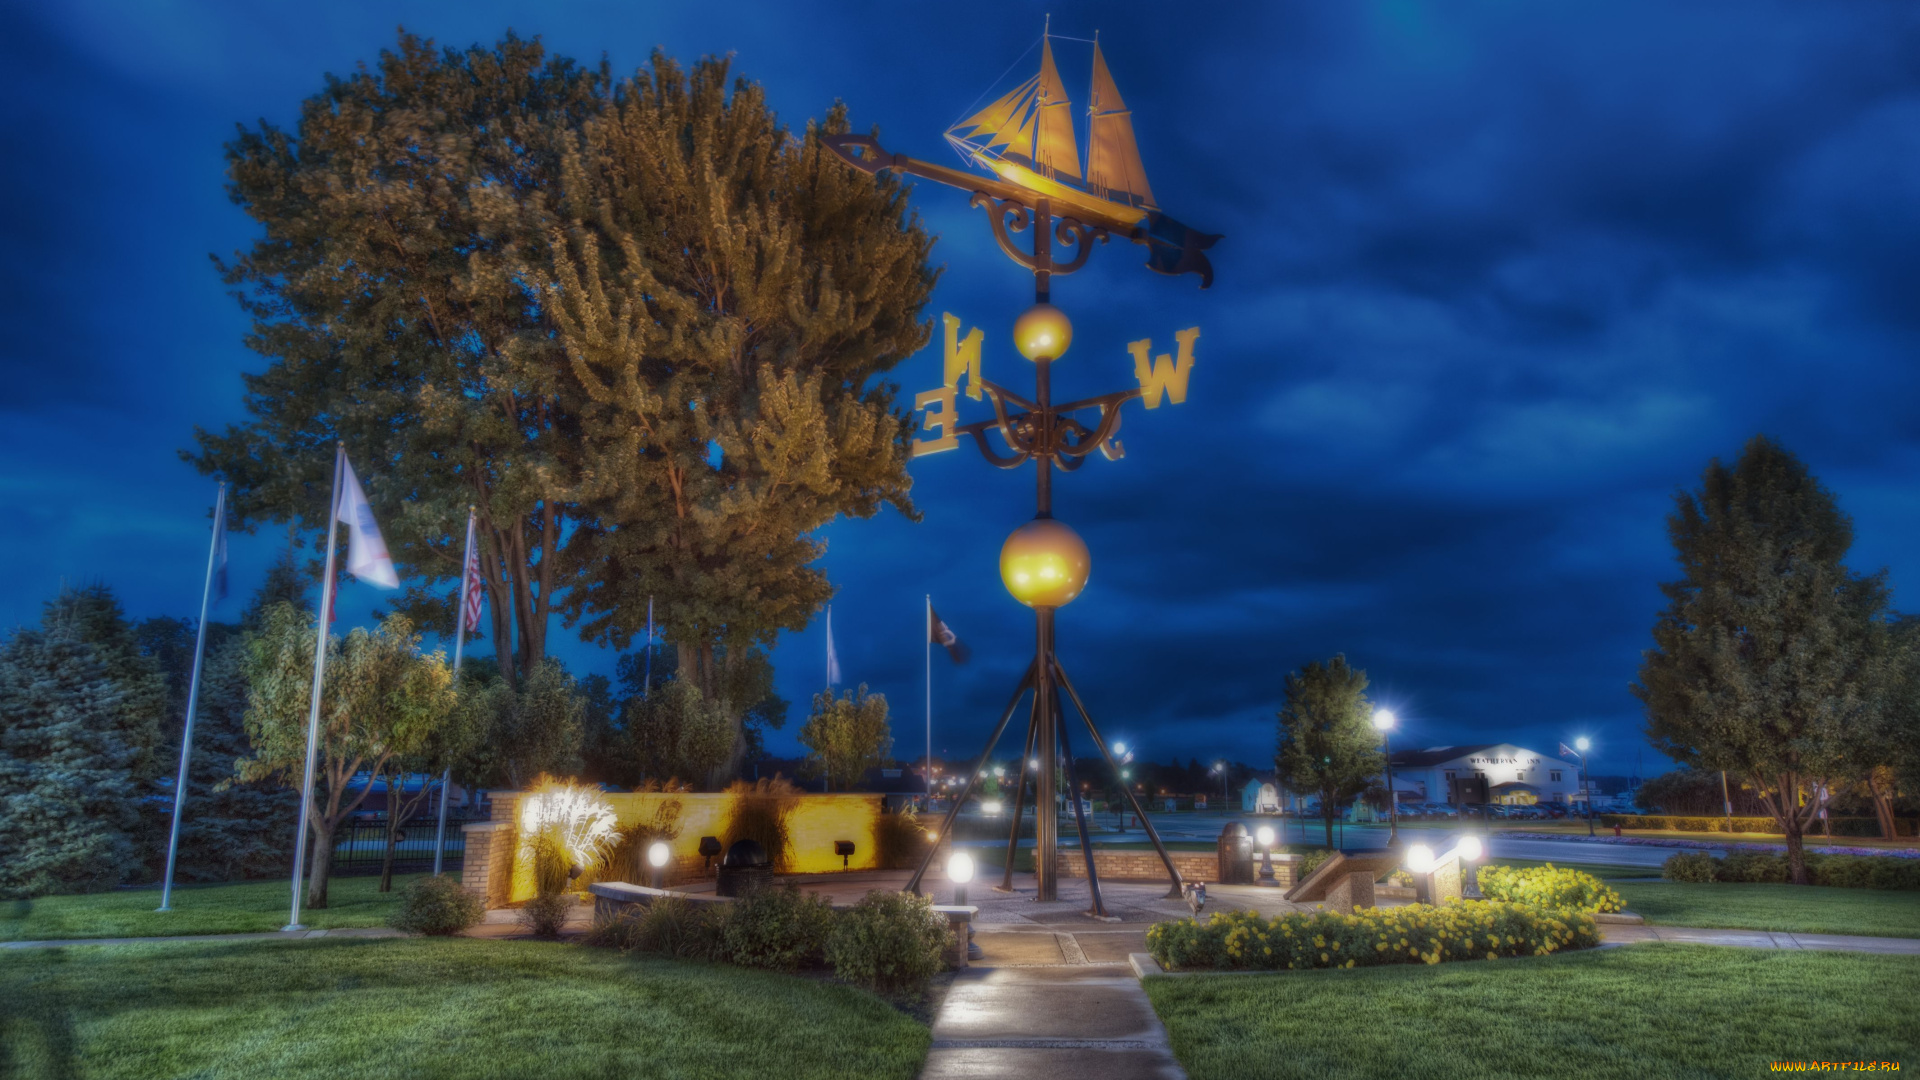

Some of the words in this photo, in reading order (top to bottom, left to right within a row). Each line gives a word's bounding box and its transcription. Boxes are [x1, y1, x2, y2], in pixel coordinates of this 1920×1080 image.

[1127, 326, 1200, 409] W
[1469, 757, 1519, 765] WEATHERVAN
[1526, 757, 1541, 765] INN
